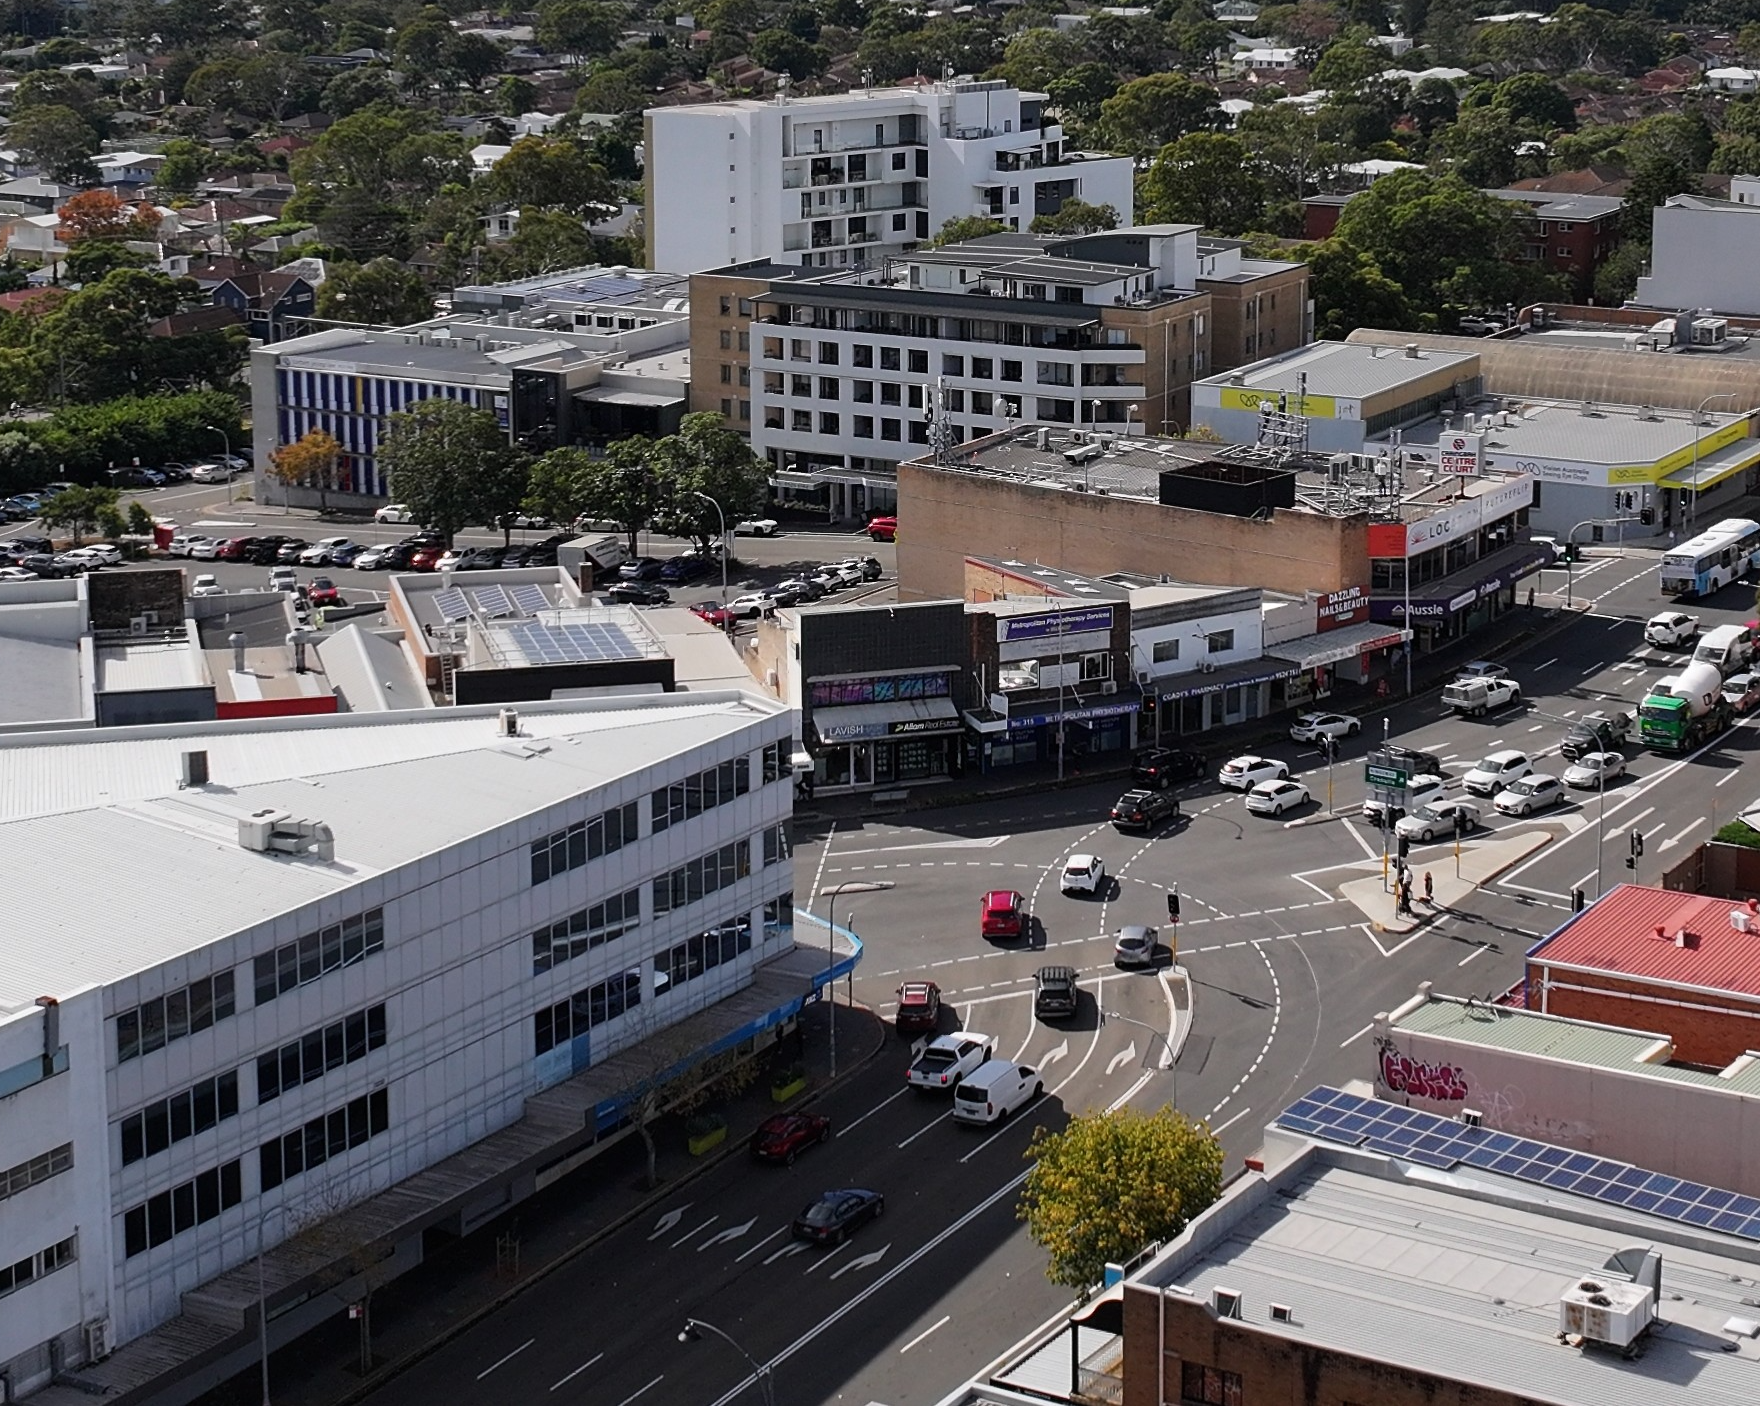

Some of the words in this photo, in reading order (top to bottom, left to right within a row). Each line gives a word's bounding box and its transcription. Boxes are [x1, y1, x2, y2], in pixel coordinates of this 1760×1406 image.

[1329, 586, 1360, 604] DAZZLING
[1409, 604, 1444, 615] Aussie
[1046, 614, 1086, 626] Physotherapy
[829, 725, 864, 736] LAVISH
